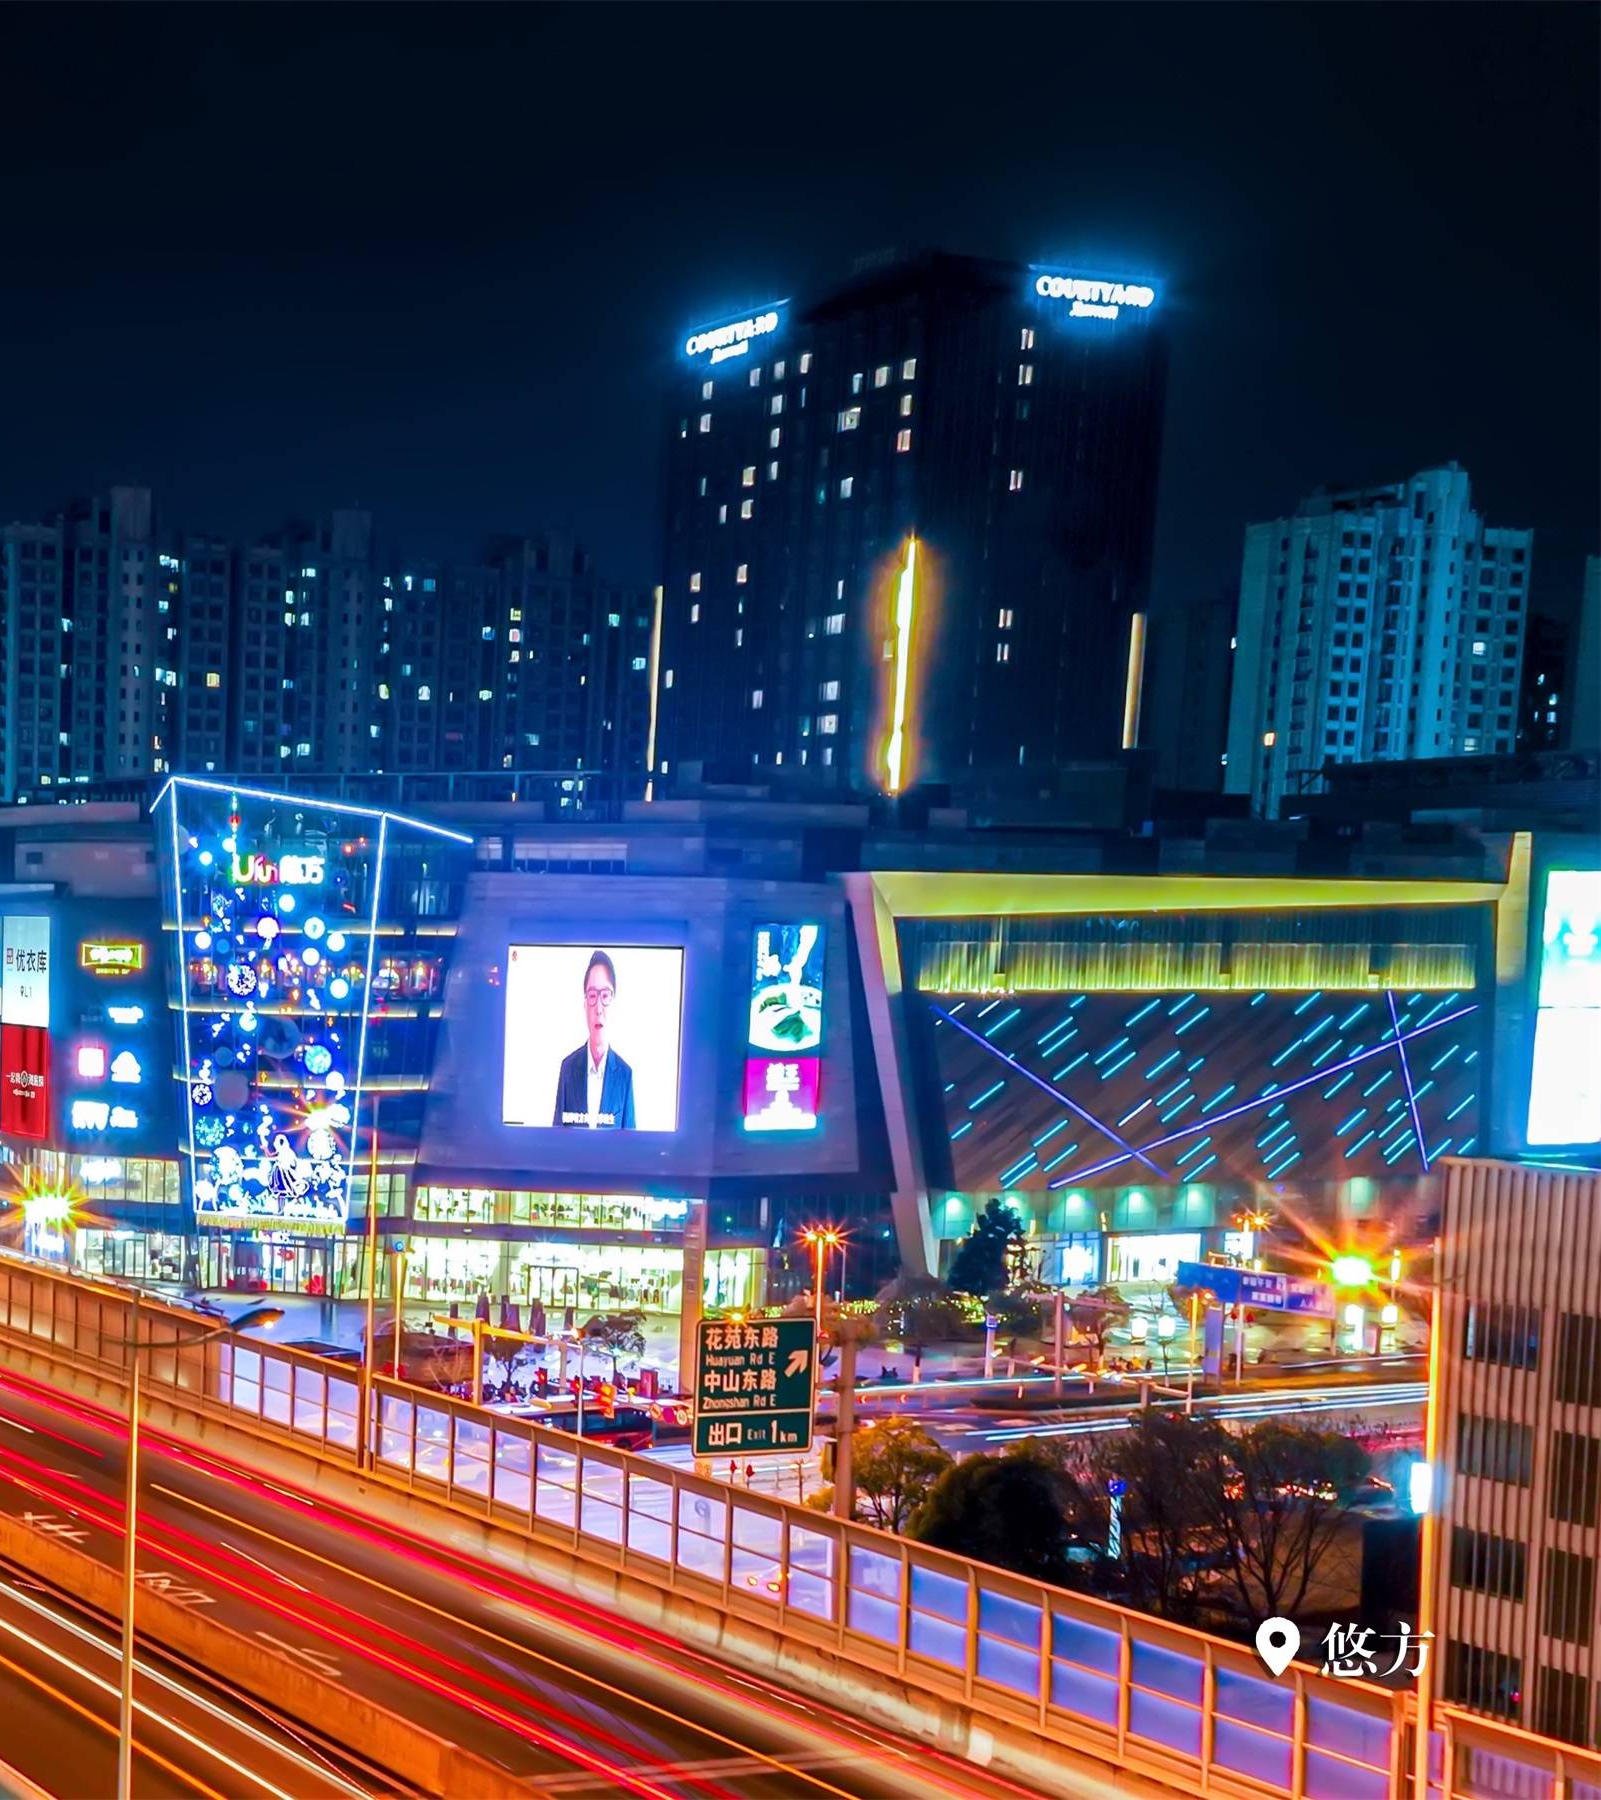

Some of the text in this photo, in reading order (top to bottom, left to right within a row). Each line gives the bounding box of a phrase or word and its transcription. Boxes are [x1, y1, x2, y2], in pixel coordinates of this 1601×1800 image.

[16, 949, 47, 972] 优衣库
[706, 1327, 778, 1350] 花苑东路
[706, 1353, 775, 1367] Huayuan Rd E
[704, 1369, 776, 1393] 中山东路
[703, 1394, 776, 1410] Zhongshan Rd E
[708, 1422, 743, 1446] 出口
[747, 1428, 767, 1441] Exit
